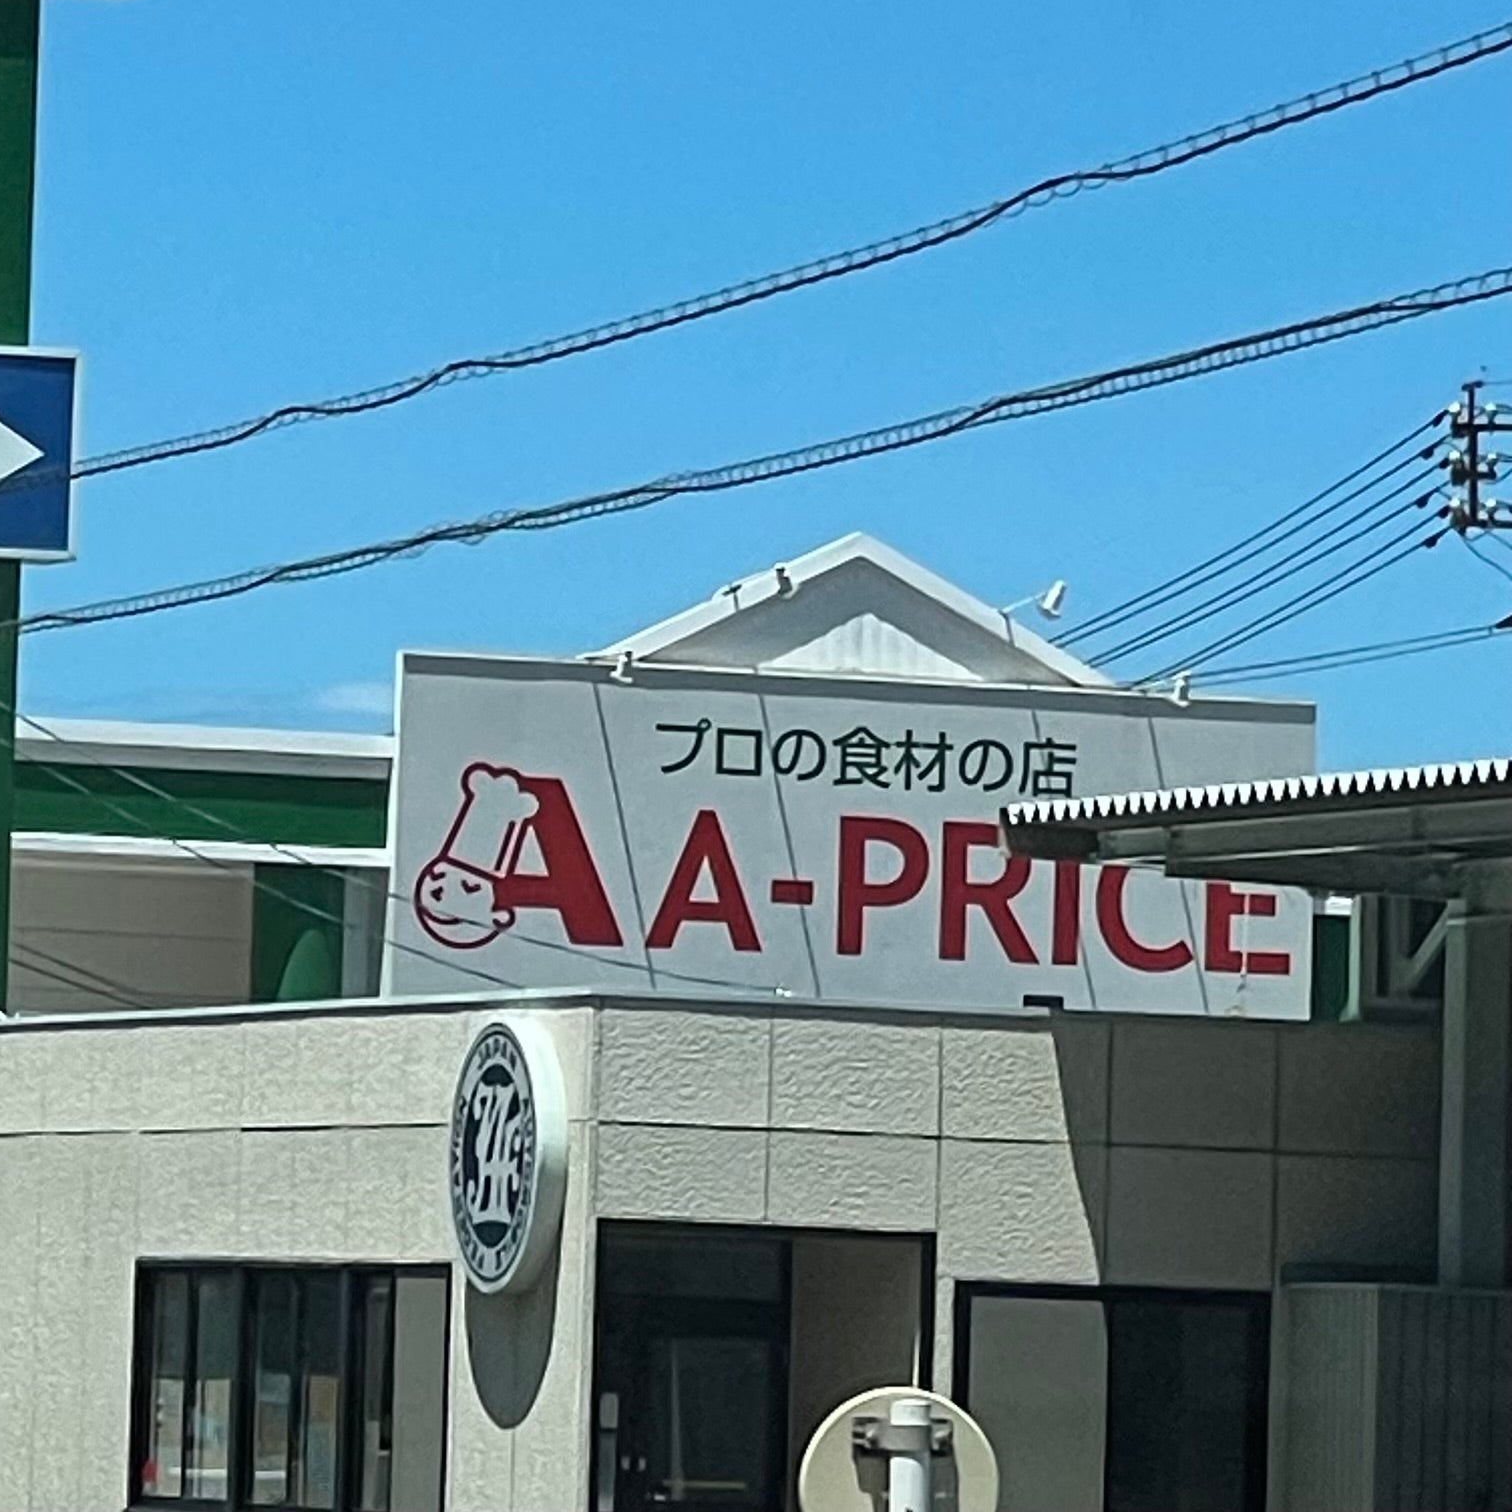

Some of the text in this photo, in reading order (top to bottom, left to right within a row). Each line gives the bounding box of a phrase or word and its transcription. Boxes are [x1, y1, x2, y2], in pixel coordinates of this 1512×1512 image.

[654, 717, 1079, 798] プロの食材の店
[645, 809, 1292, 976] A-PRICE
